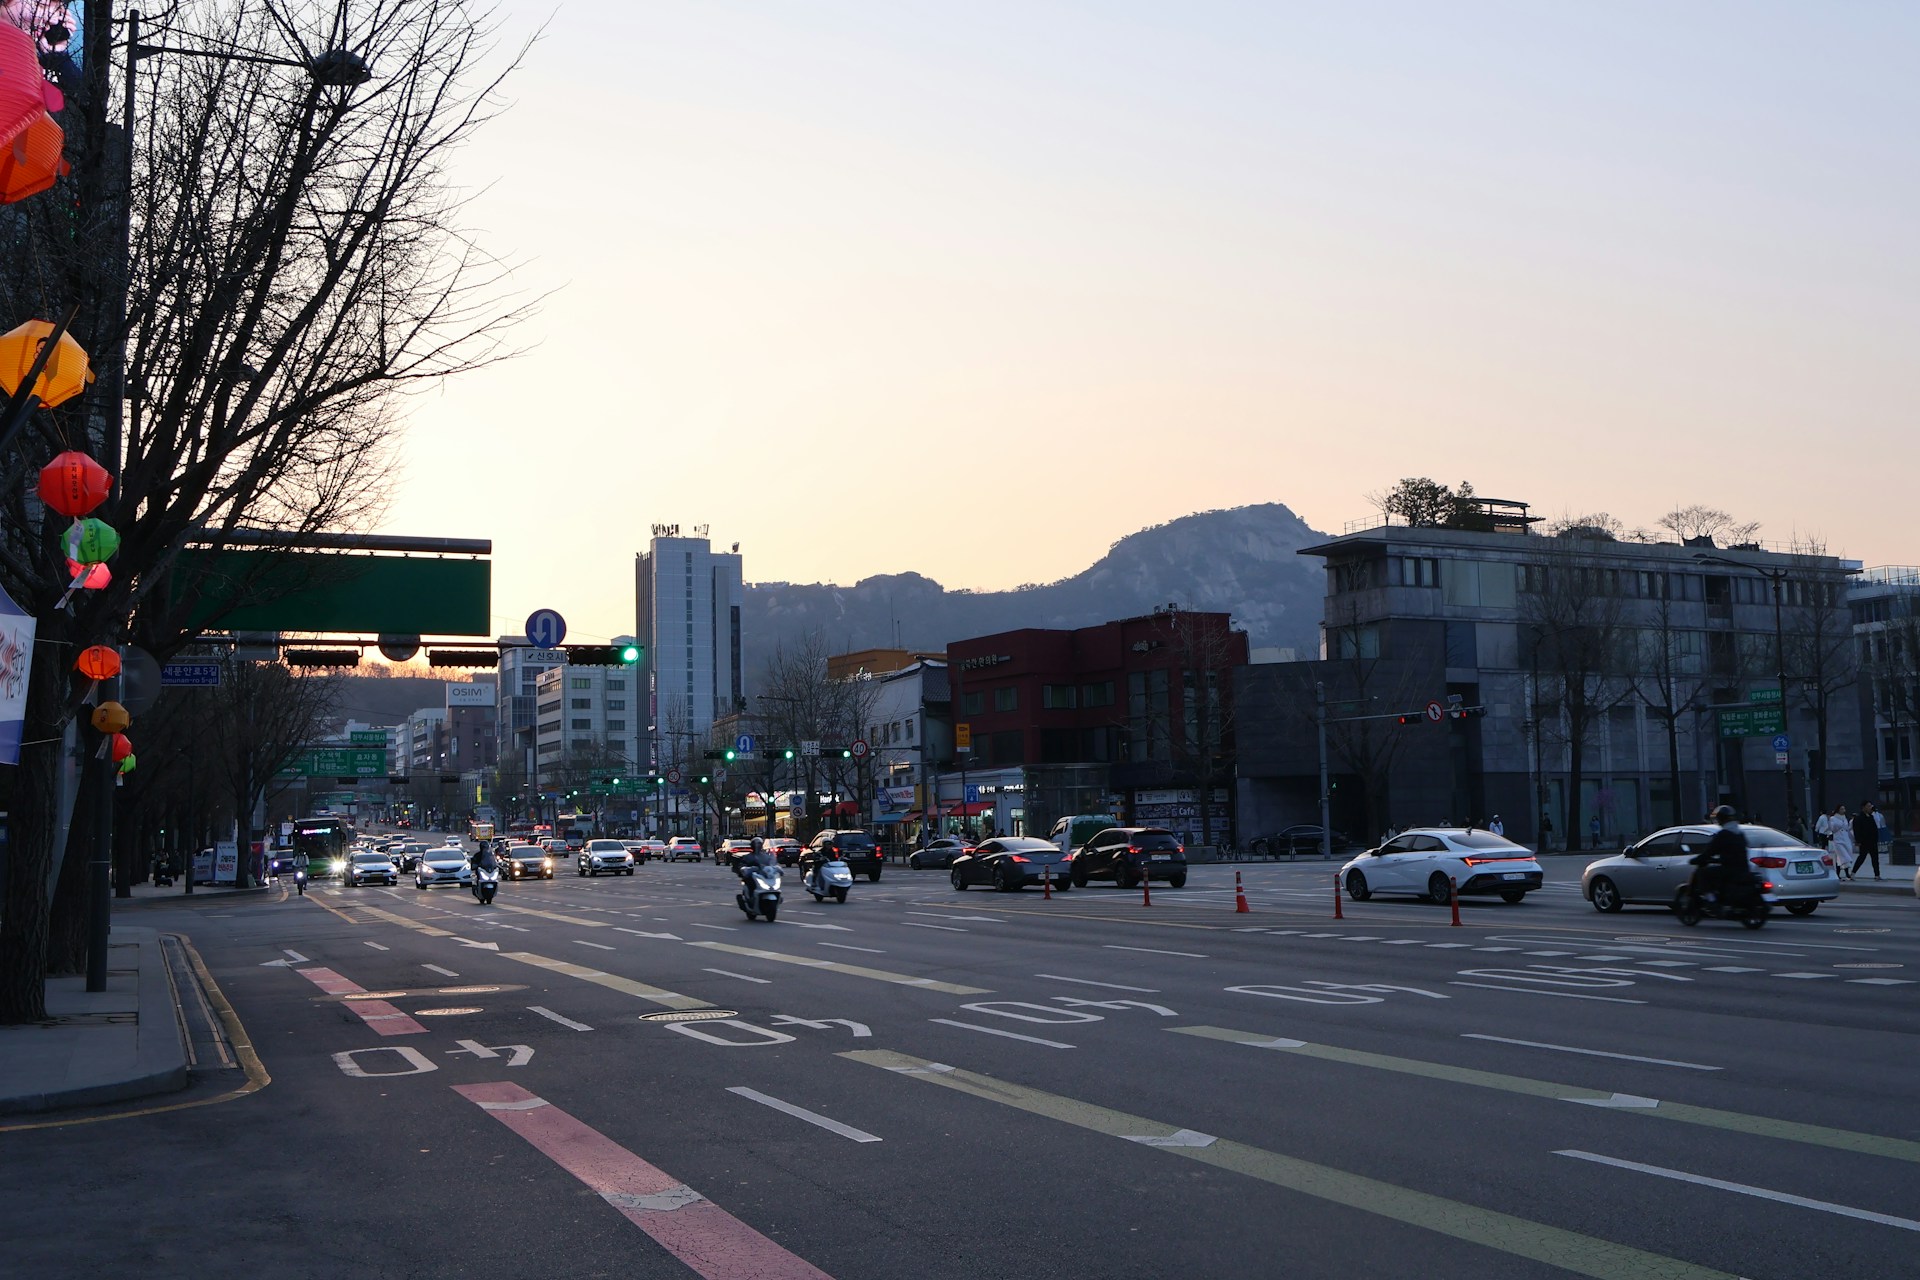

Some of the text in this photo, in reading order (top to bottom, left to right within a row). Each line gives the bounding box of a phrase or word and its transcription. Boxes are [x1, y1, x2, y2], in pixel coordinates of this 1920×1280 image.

[163, 666, 217, 677] 새문안로5길
[452, 687, 483, 697] OSIM
[959, 996, 1180, 1024] 40
[664, 1014, 873, 1047] 40
[331, 1039, 535, 1078] 40
